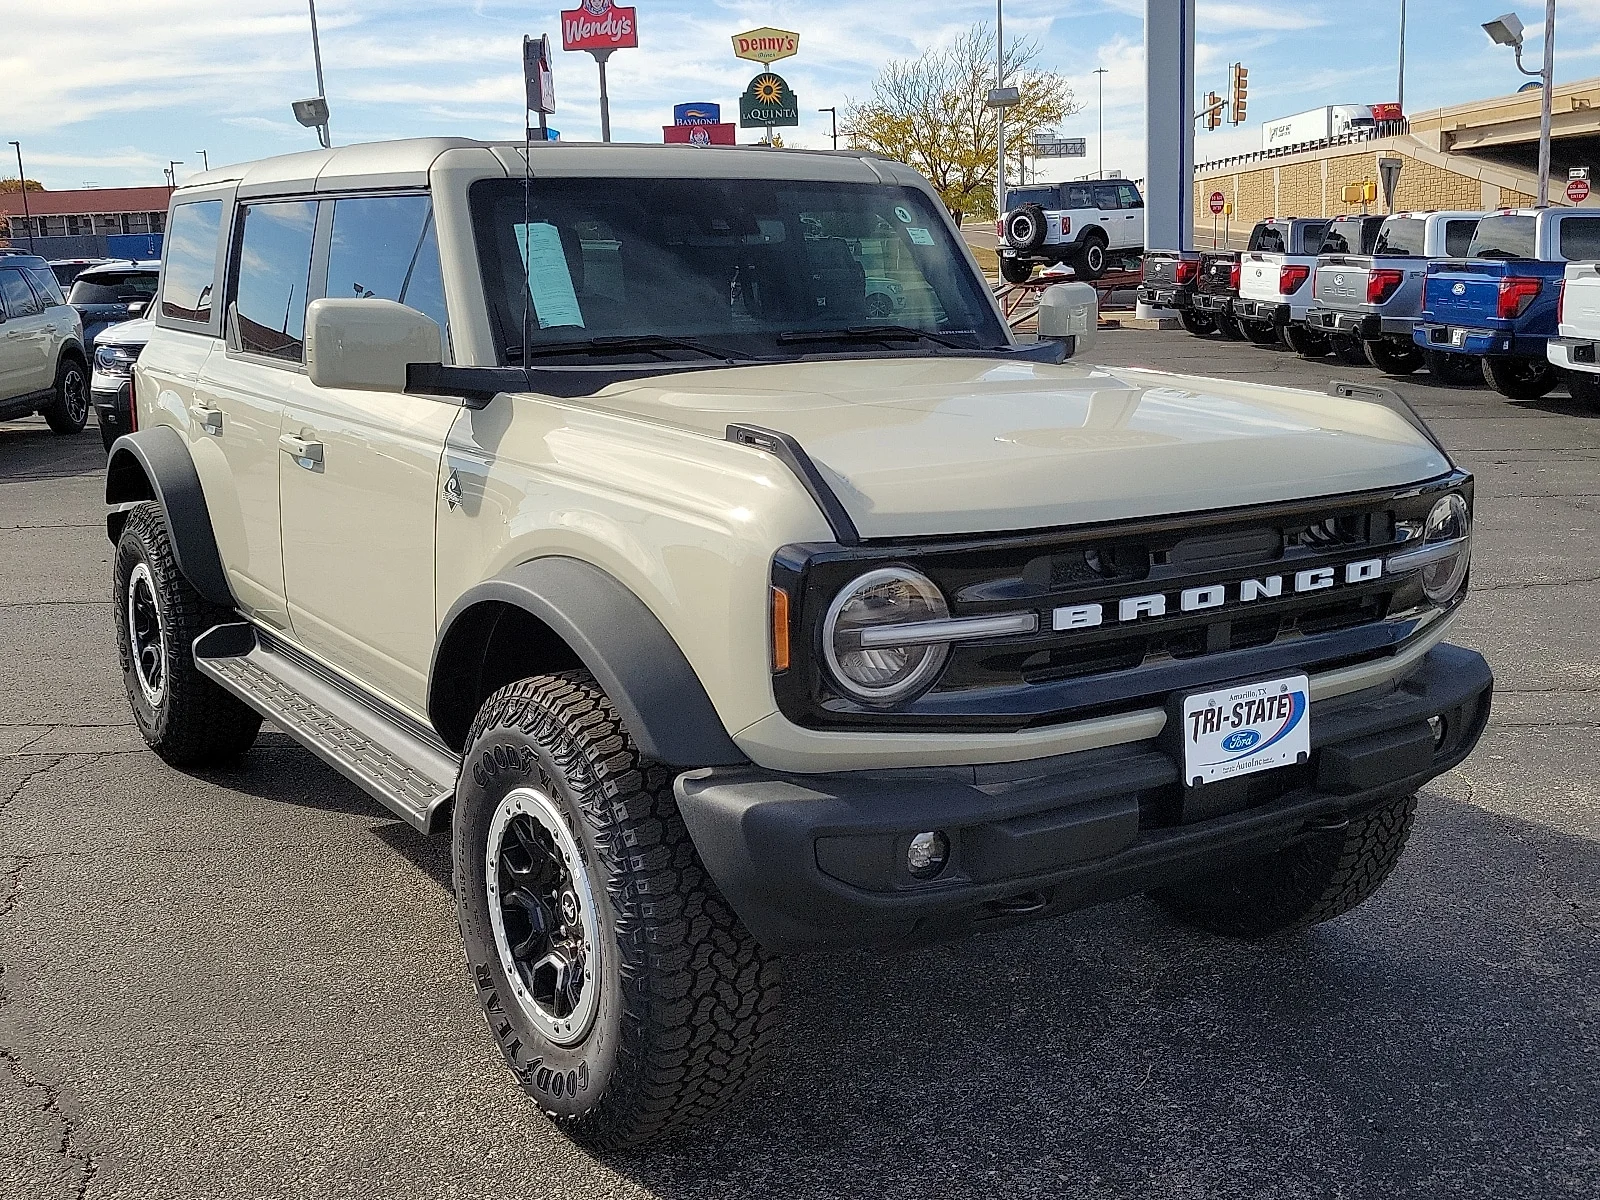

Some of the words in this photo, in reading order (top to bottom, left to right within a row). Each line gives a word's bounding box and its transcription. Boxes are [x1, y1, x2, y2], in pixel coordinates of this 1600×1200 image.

[565, 12, 632, 43] Wendy's
[738, 35, 794, 53] Denny's
[751, 108, 797, 121] QUINTA
[1052, 559, 1383, 631] BRONCO
[1188, 693, 1289, 744] TRI-STATE
[1229, 733, 1253, 749] Ford
